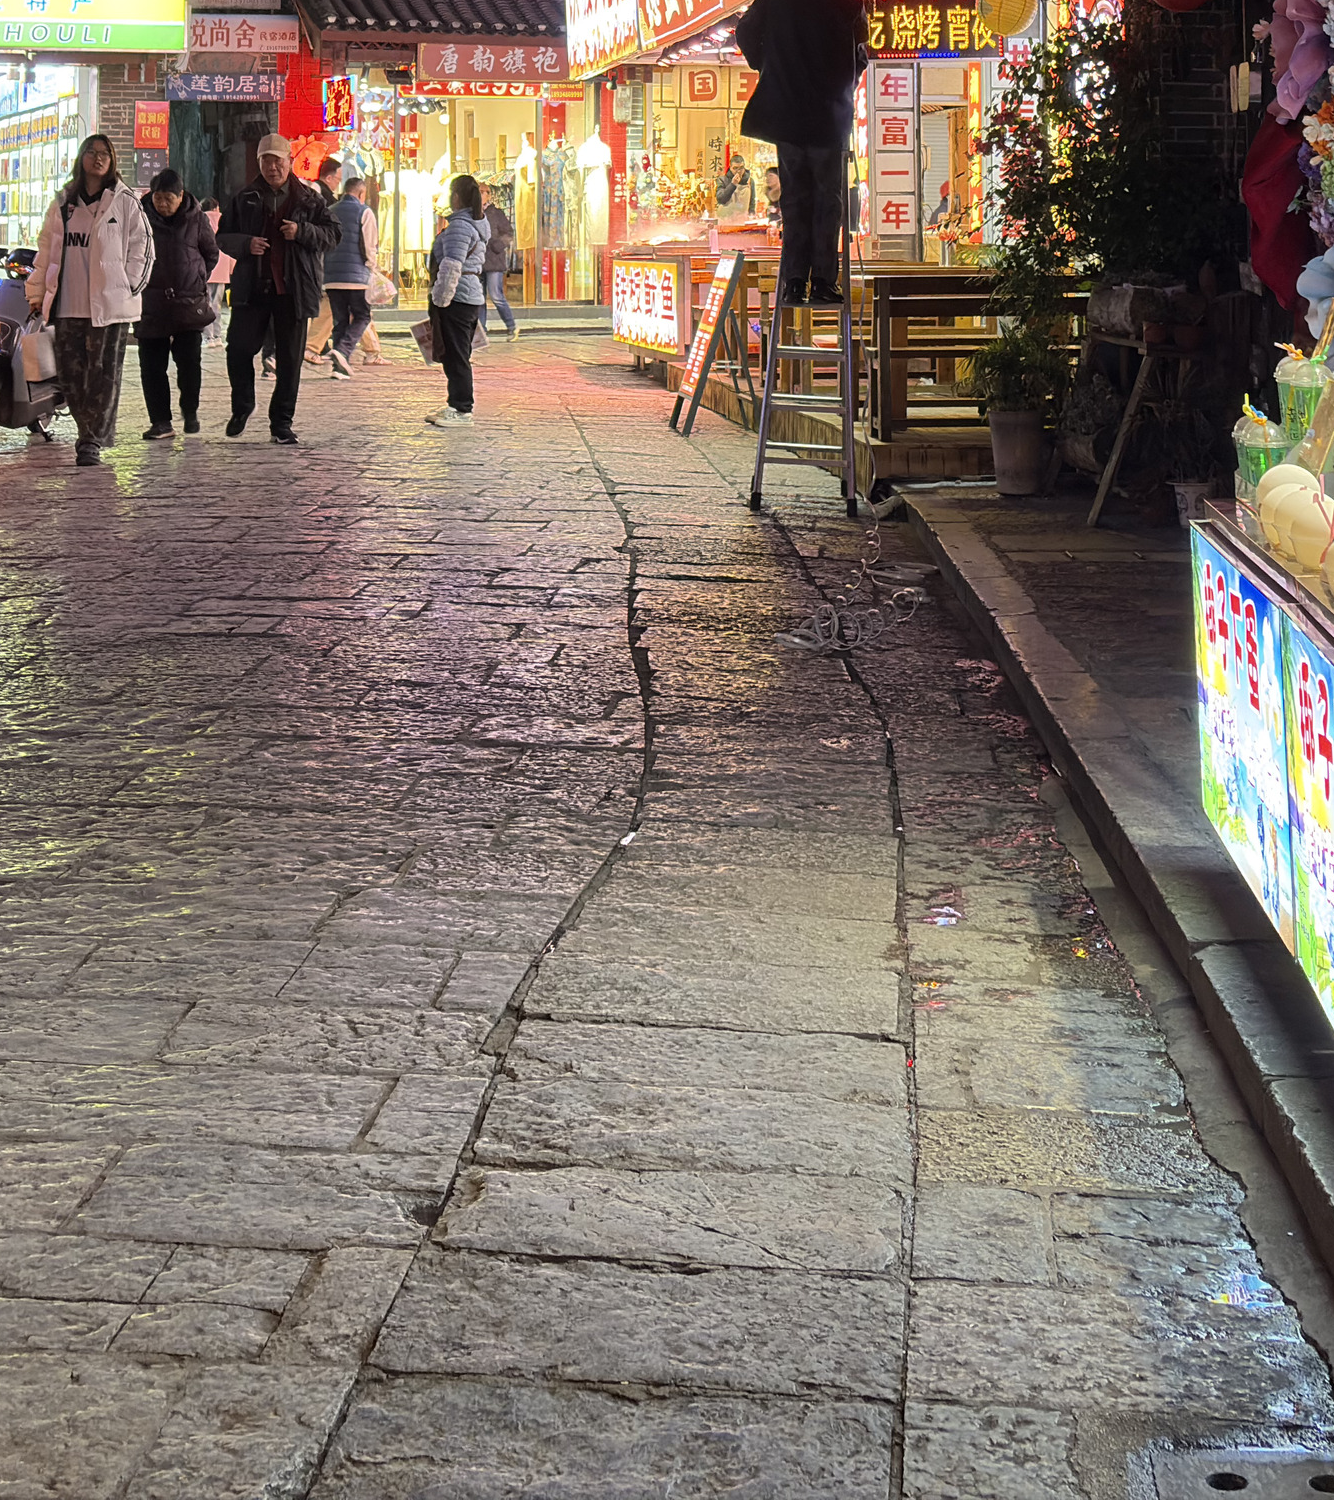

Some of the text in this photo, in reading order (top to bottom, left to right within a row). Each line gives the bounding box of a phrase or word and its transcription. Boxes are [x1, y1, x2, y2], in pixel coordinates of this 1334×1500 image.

[891, 4, 941, 51] 烧烤
[435, 43, 561, 75] 唐韵旗袍
[190, 74, 257, 93] 莲韵居
